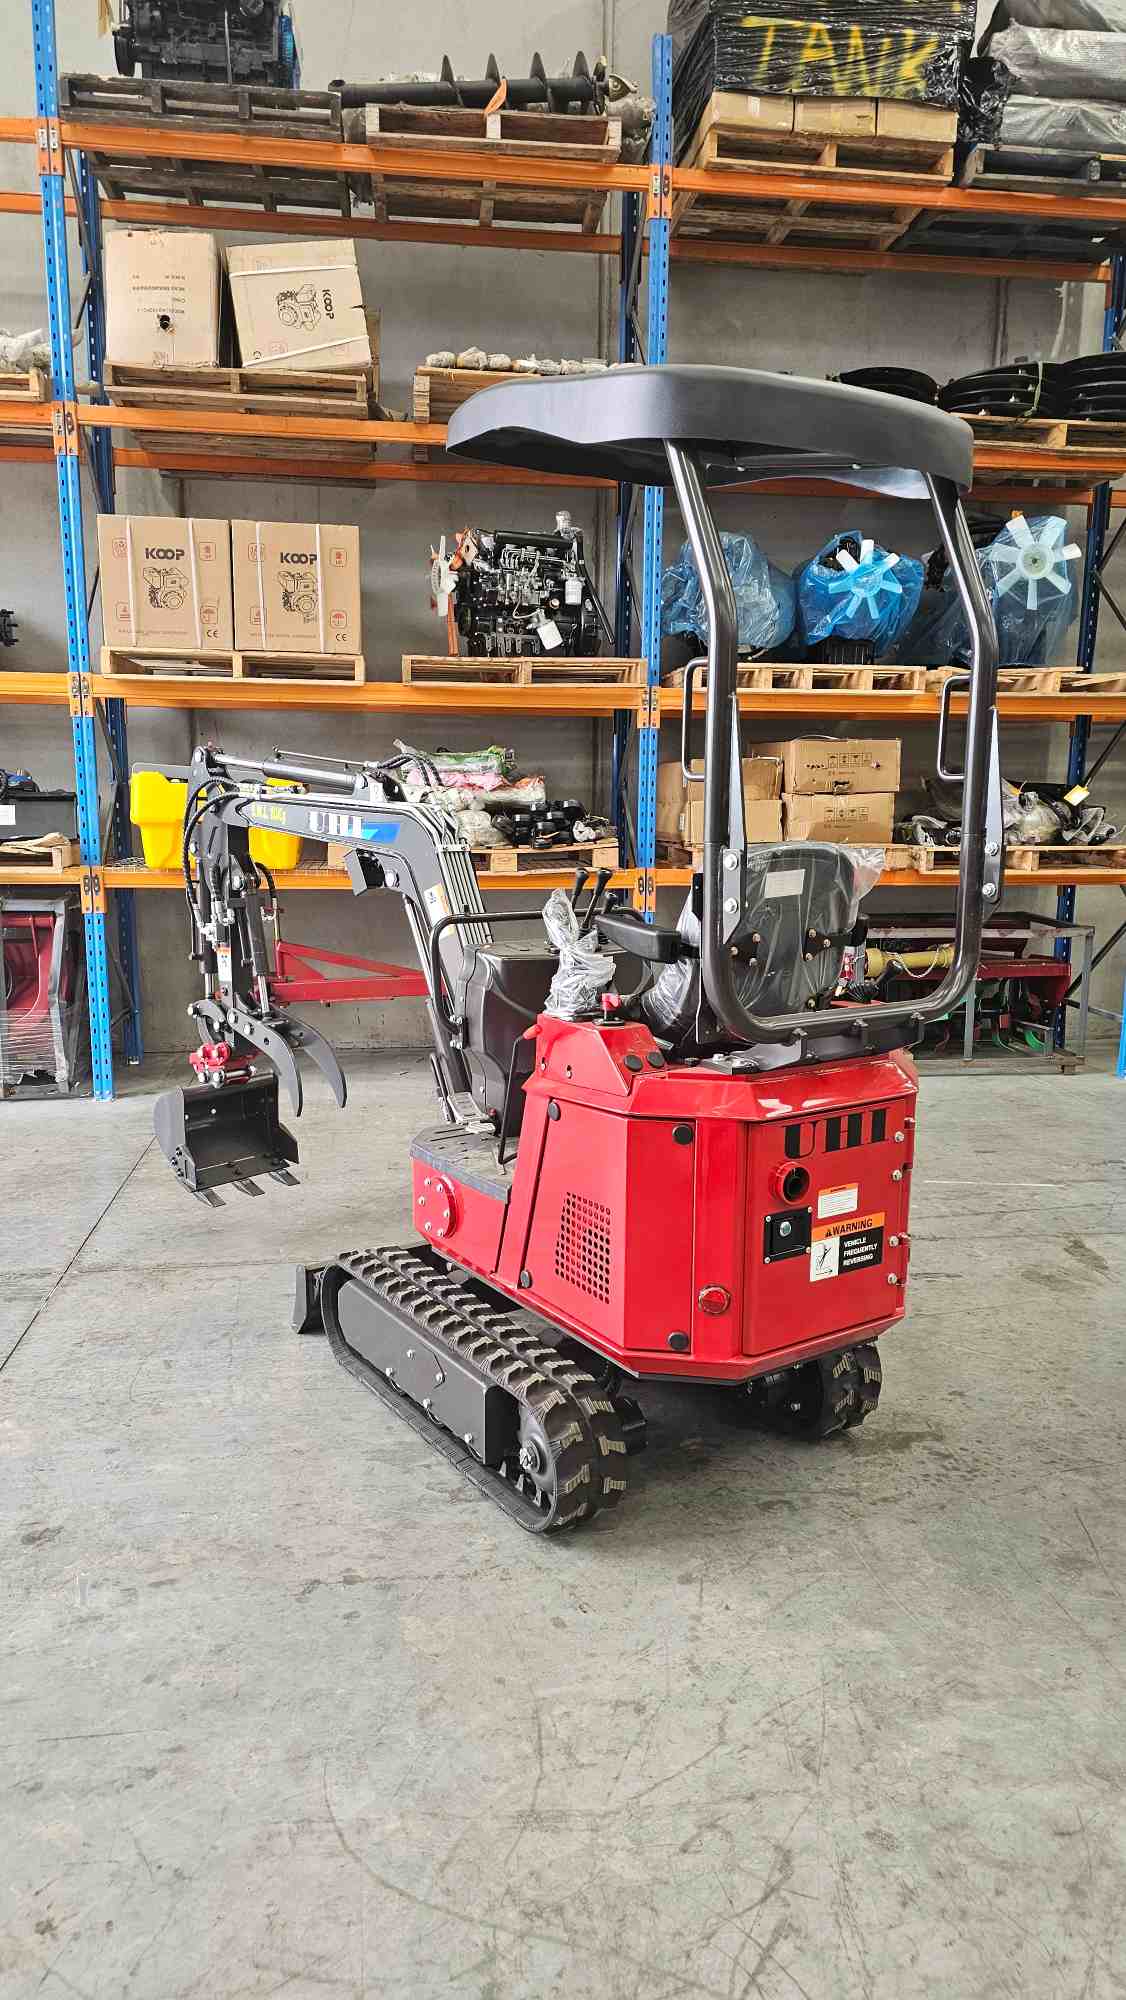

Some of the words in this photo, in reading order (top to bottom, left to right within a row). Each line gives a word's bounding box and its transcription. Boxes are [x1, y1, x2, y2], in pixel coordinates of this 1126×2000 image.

[739, 16, 938, 96] TANK
[322, 289, 335, 320] KOOP
[145, 547, 185, 561] KOOP
[280, 552, 318, 565] KOOP
[782, 1108, 891, 1160] UHI
[832, 1218, 873, 1237] WARNING
[843, 1236, 867, 1249] VEHICLE
[843, 1243, 878, 1258] FREQUENTLY
[843, 1253, 874, 1266] REVERSING
